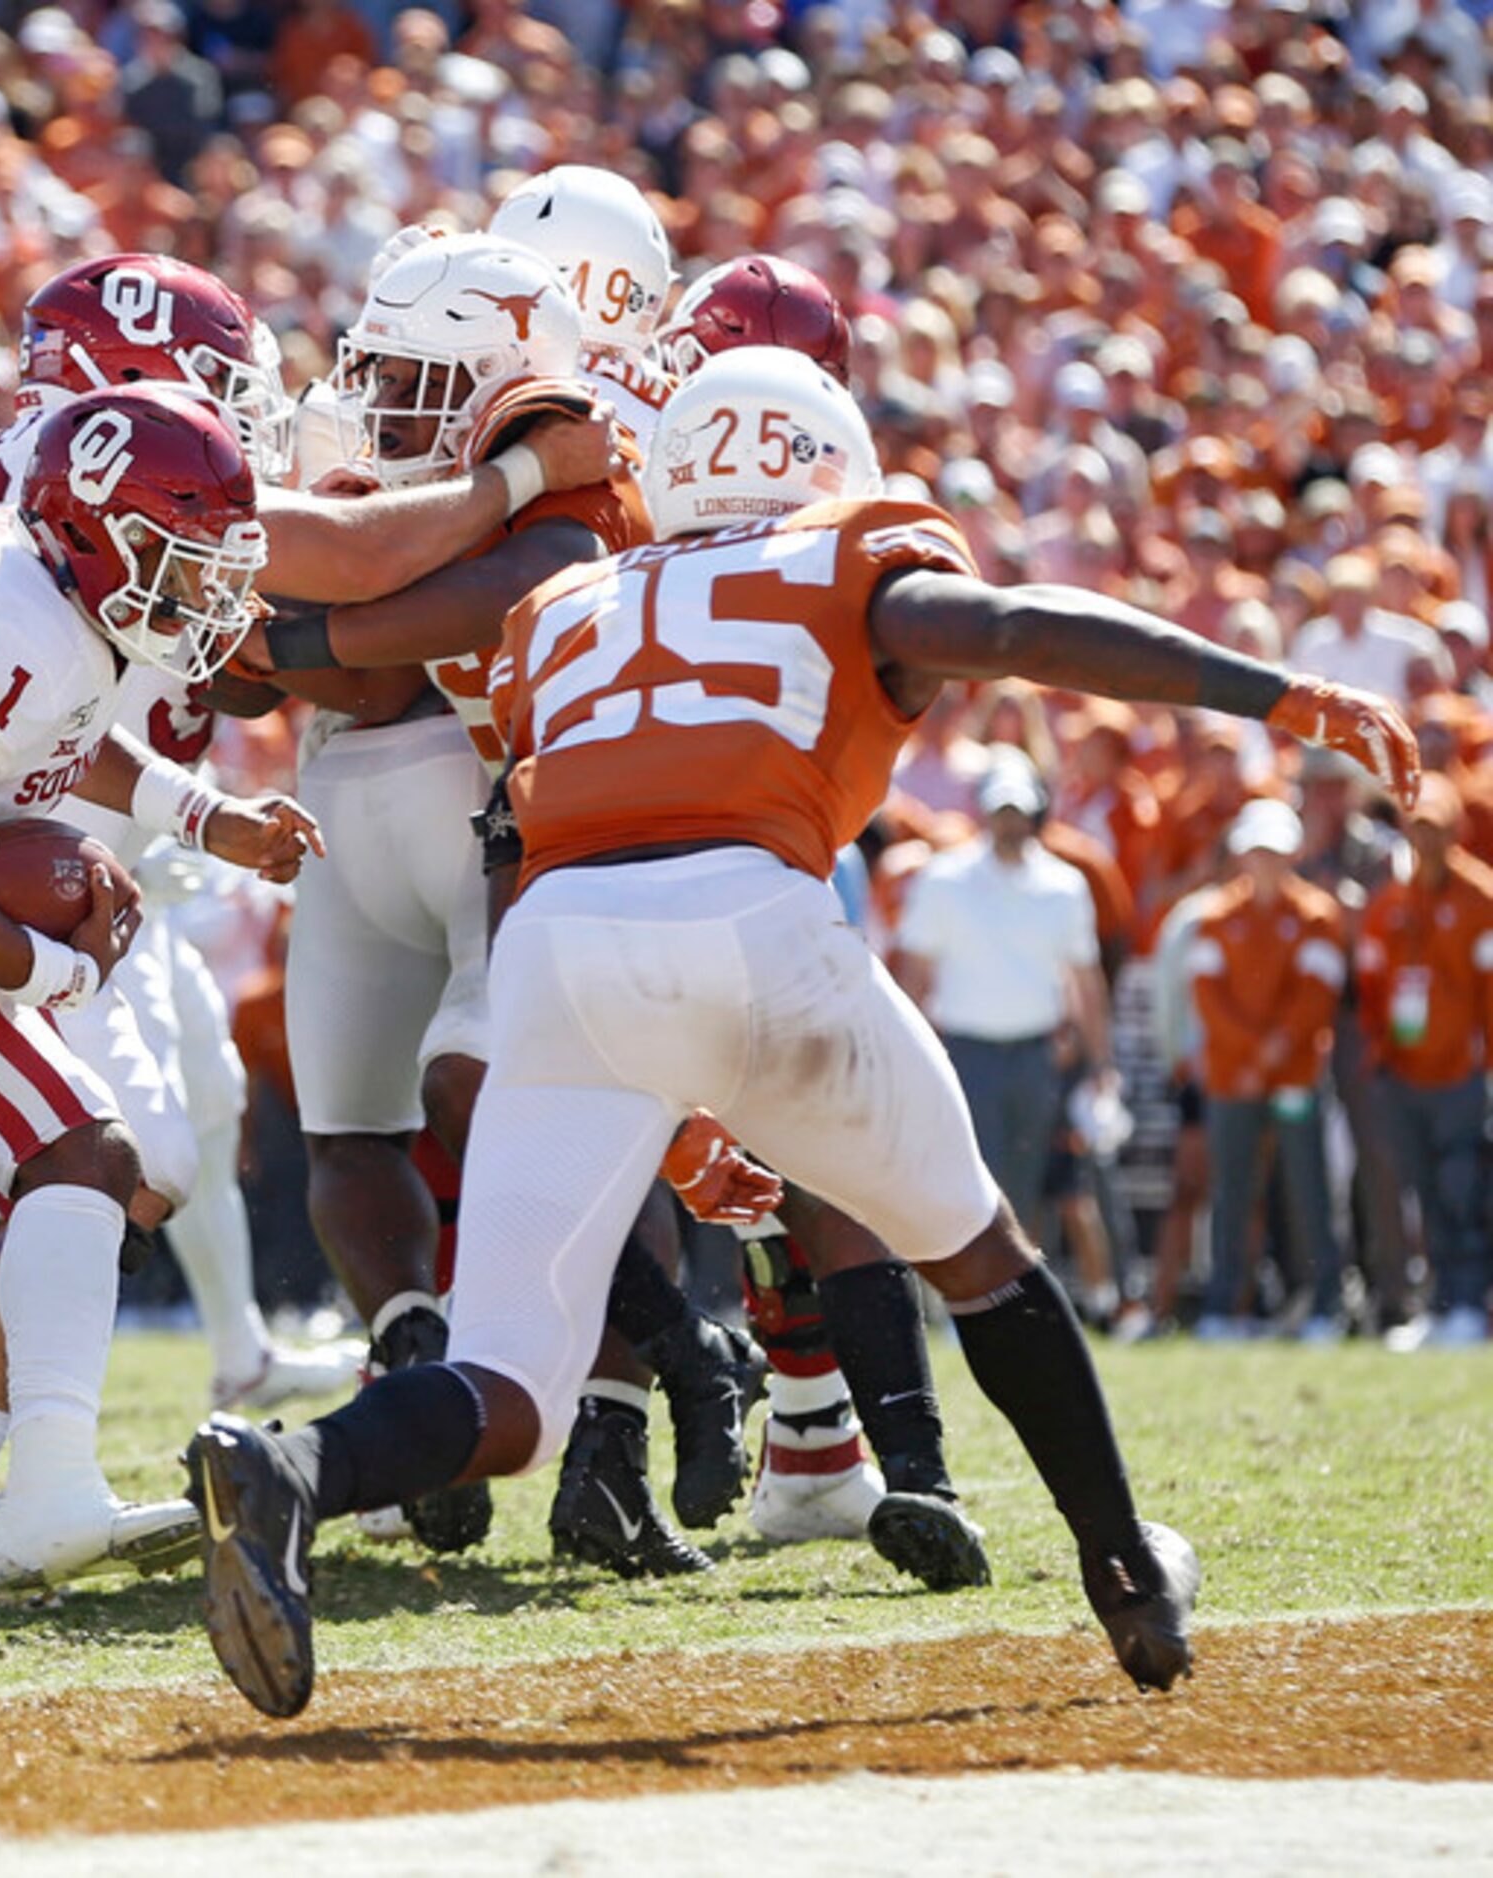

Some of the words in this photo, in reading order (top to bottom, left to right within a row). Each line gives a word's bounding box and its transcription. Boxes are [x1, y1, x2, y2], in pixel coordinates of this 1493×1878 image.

[102, 269, 174, 346] OU
[571, 261, 631, 325] 19
[69, 409, 134, 505] OU
[708, 408, 791, 479] 25
[525, 528, 840, 755] 25
